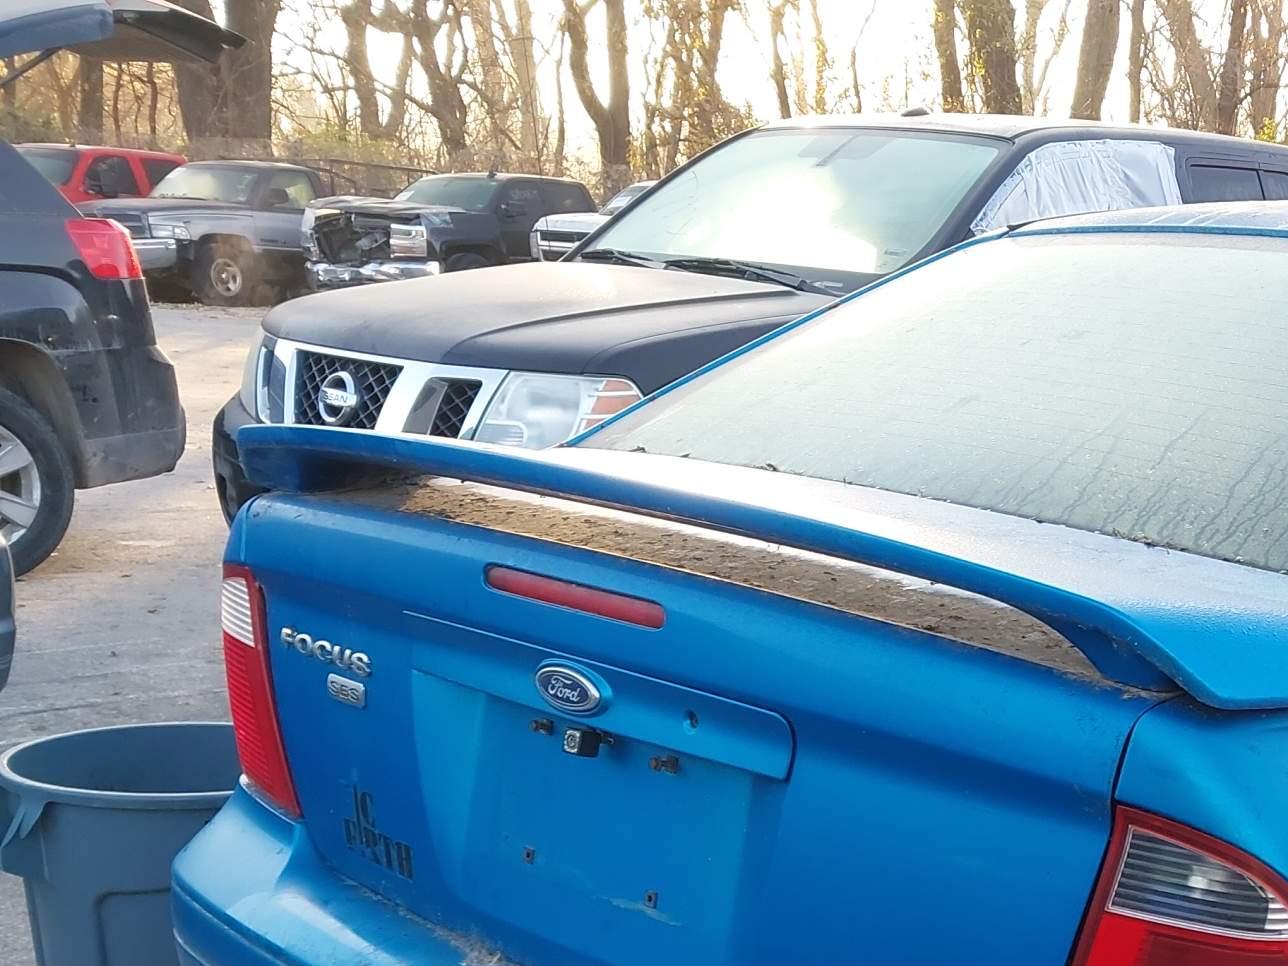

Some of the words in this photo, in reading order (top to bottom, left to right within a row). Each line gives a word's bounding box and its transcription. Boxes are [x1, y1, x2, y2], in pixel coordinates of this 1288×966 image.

[281, 627, 371, 675] FOCUS
[328, 680, 360, 703] SES
[548, 675, 581, 702] Ford
